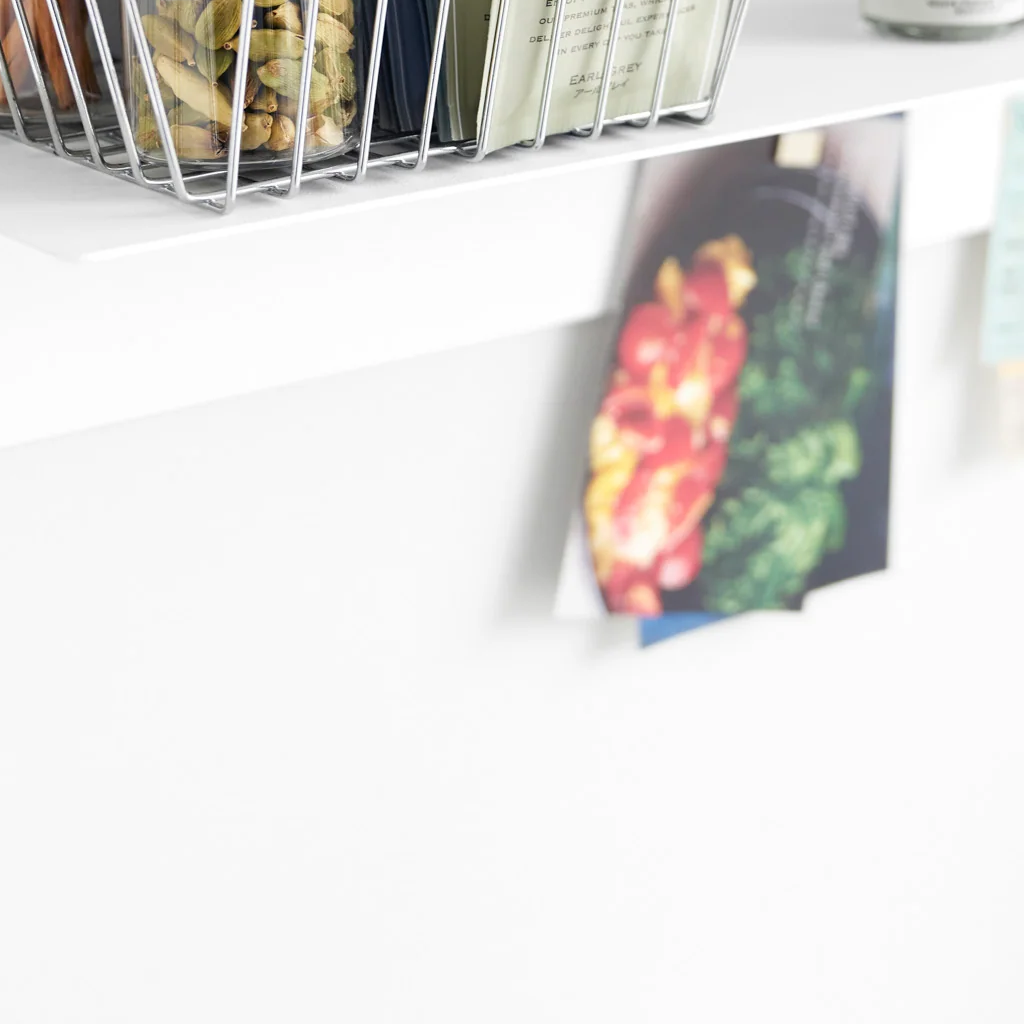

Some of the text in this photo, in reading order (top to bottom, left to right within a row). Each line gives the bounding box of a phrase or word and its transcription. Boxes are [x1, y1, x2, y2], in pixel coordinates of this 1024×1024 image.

[539, 17, 555, 25] OU
[564, 7, 608, 22] PREMIUM
[529, 30, 572, 44] DELER
[574, 18, 633, 37] DELIGHUL
[571, 40, 601, 54] EVERY
[569, 70, 603, 86] EARL
